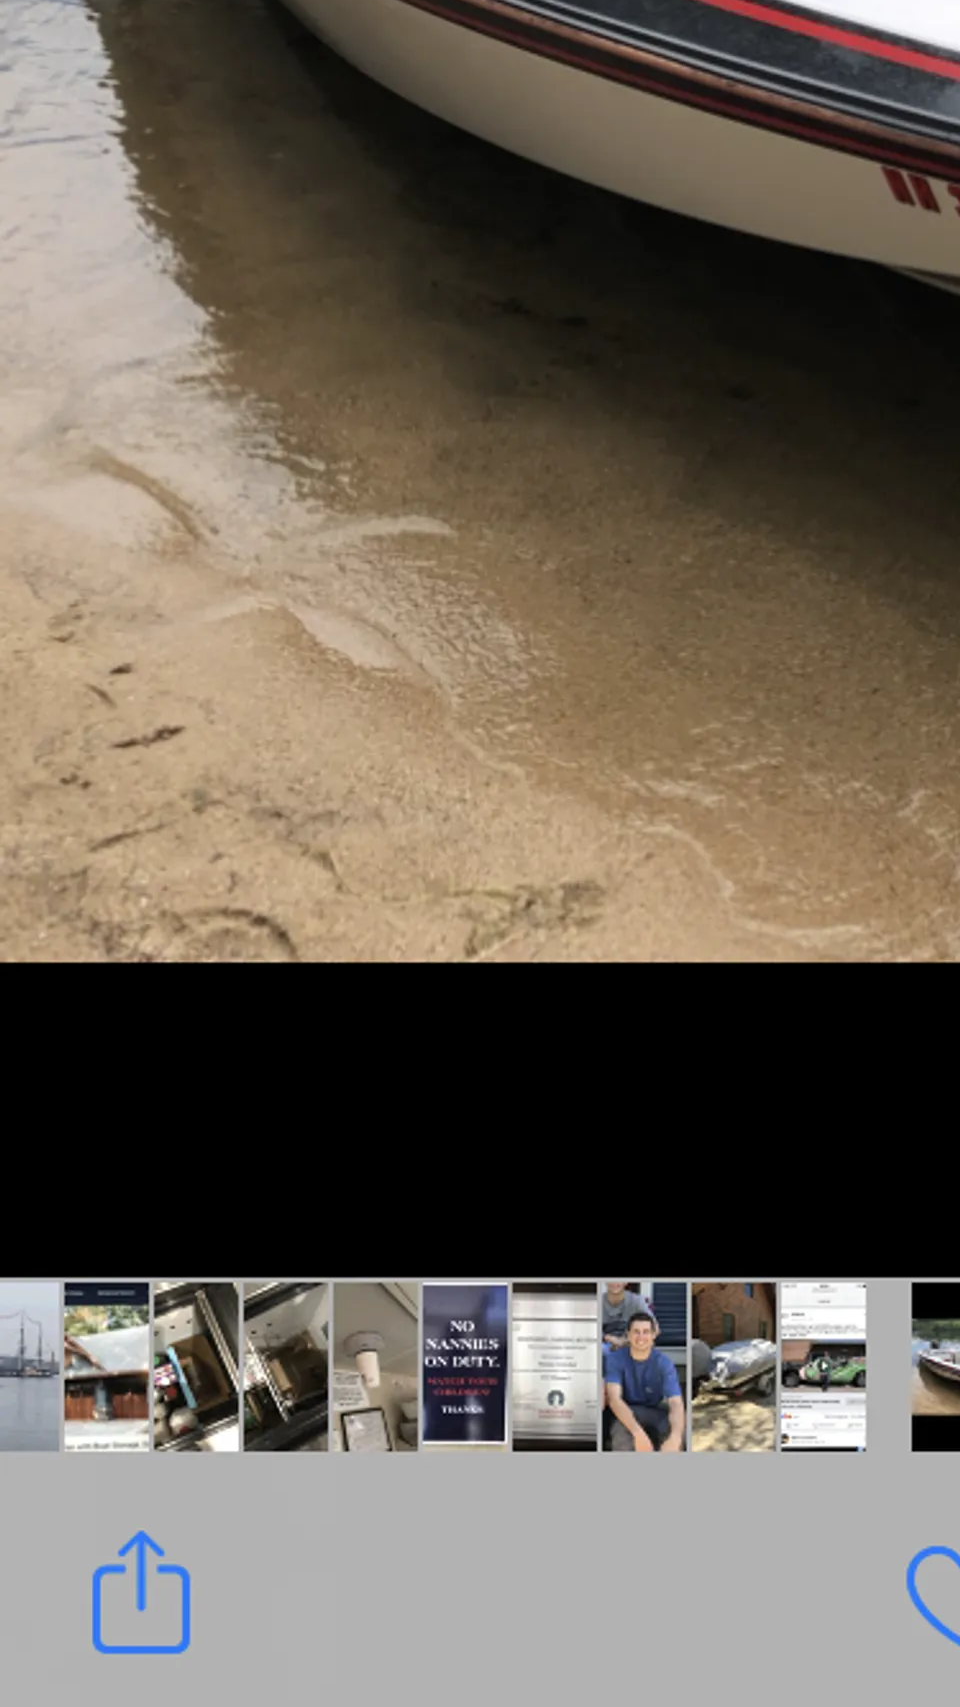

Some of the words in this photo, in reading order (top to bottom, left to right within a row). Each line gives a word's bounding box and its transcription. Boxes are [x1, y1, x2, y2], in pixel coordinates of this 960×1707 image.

[449, 1319, 476, 1333] NO
[425, 1337, 500, 1350] NANNIES
[424, 1355, 450, 1368] ON
[452, 1355, 501, 1368] DUTY.
